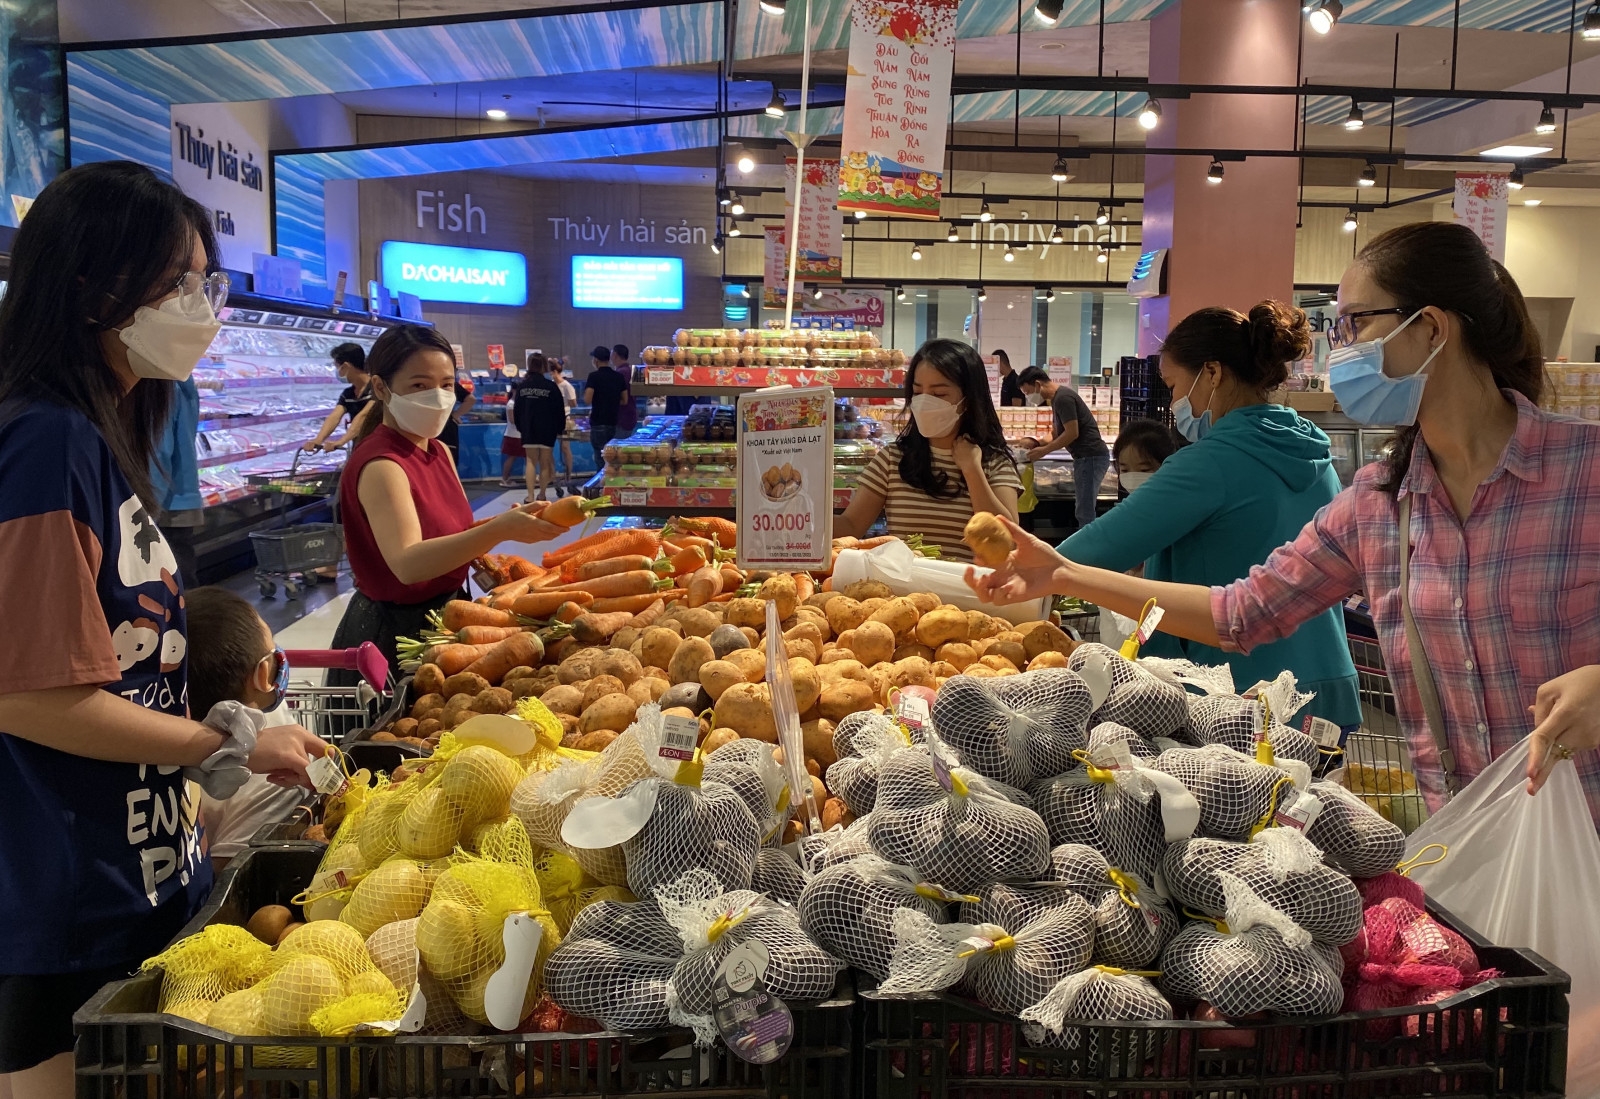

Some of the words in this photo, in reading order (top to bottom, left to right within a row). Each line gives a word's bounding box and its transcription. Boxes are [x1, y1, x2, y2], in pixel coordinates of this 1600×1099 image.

[871, 75, 897, 90] SUNG
[905, 134, 920, 148] RA
[175, 121, 215, 180] Thủy
[218, 139, 239, 182] hải
[241, 152, 263, 192] sản
[415, 190, 487, 234] Fish
[215, 210, 235, 236] Fish
[547, 216, 610, 246] Thủy
[620, 218, 655, 243] hải
[665, 220, 707, 245] sản
[960, 211, 1057, 260] Thủy
[401, 263, 506, 287] DAOHAISAN
[848, 313, 865, 323] ÀM
[867, 314, 881, 323] CÁ
[1307, 311, 1333, 332] sh
[767, 437, 779, 445] TÂY
[780, 436, 796, 445] VÀNG
[808, 435, 821, 444] LẠT
[752, 512, 811, 531] 30.000đ
[734, 993, 768, 1013] Purple
